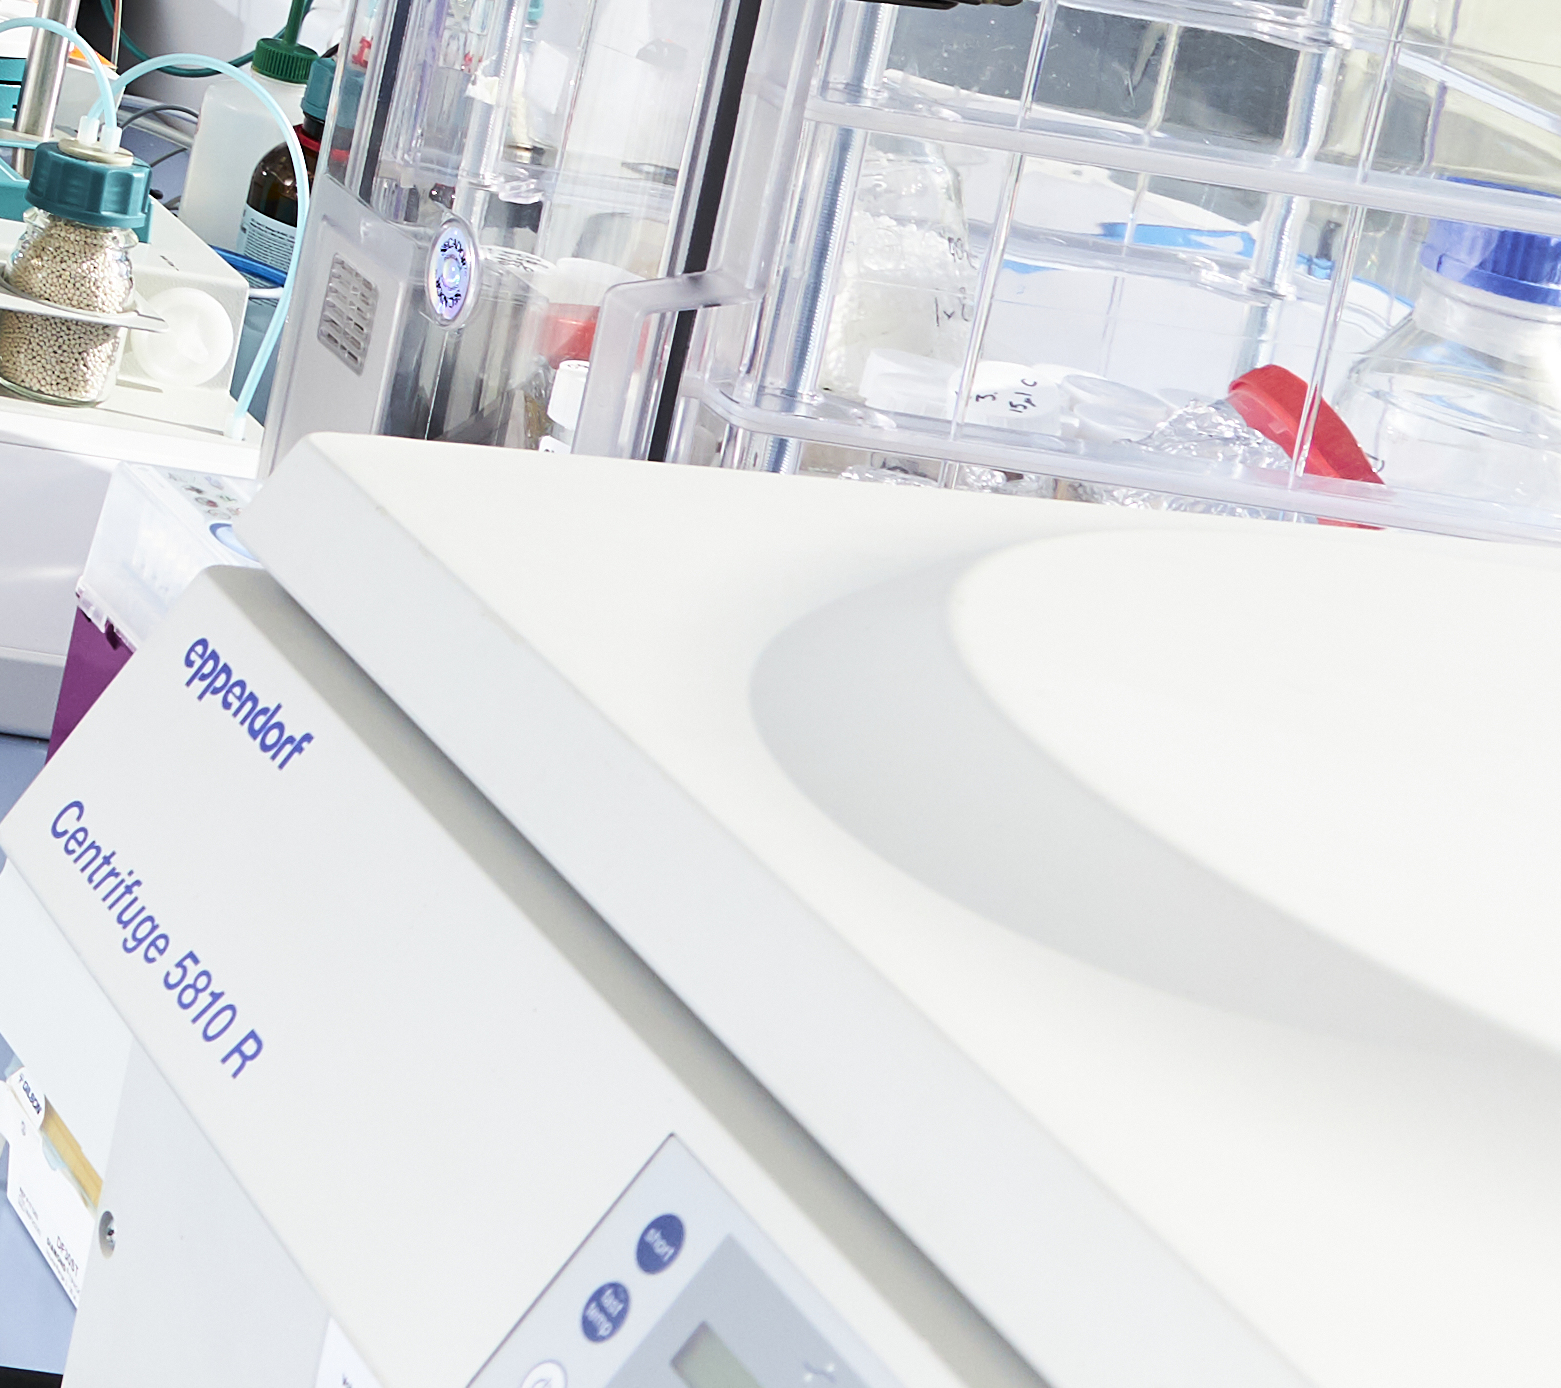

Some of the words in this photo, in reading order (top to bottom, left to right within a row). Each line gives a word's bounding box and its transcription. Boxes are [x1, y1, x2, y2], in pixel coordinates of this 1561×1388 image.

[184, 637, 314, 771] eppendorf
[50, 800, 168, 965] Centrifuge
[163, 951, 238, 1043] 5810
[220, 1029, 265, 1080] R
[644, 1227, 675, 1262] short
[585, 1301, 613, 1337] temp
[600, 1288, 625, 1317] fast
